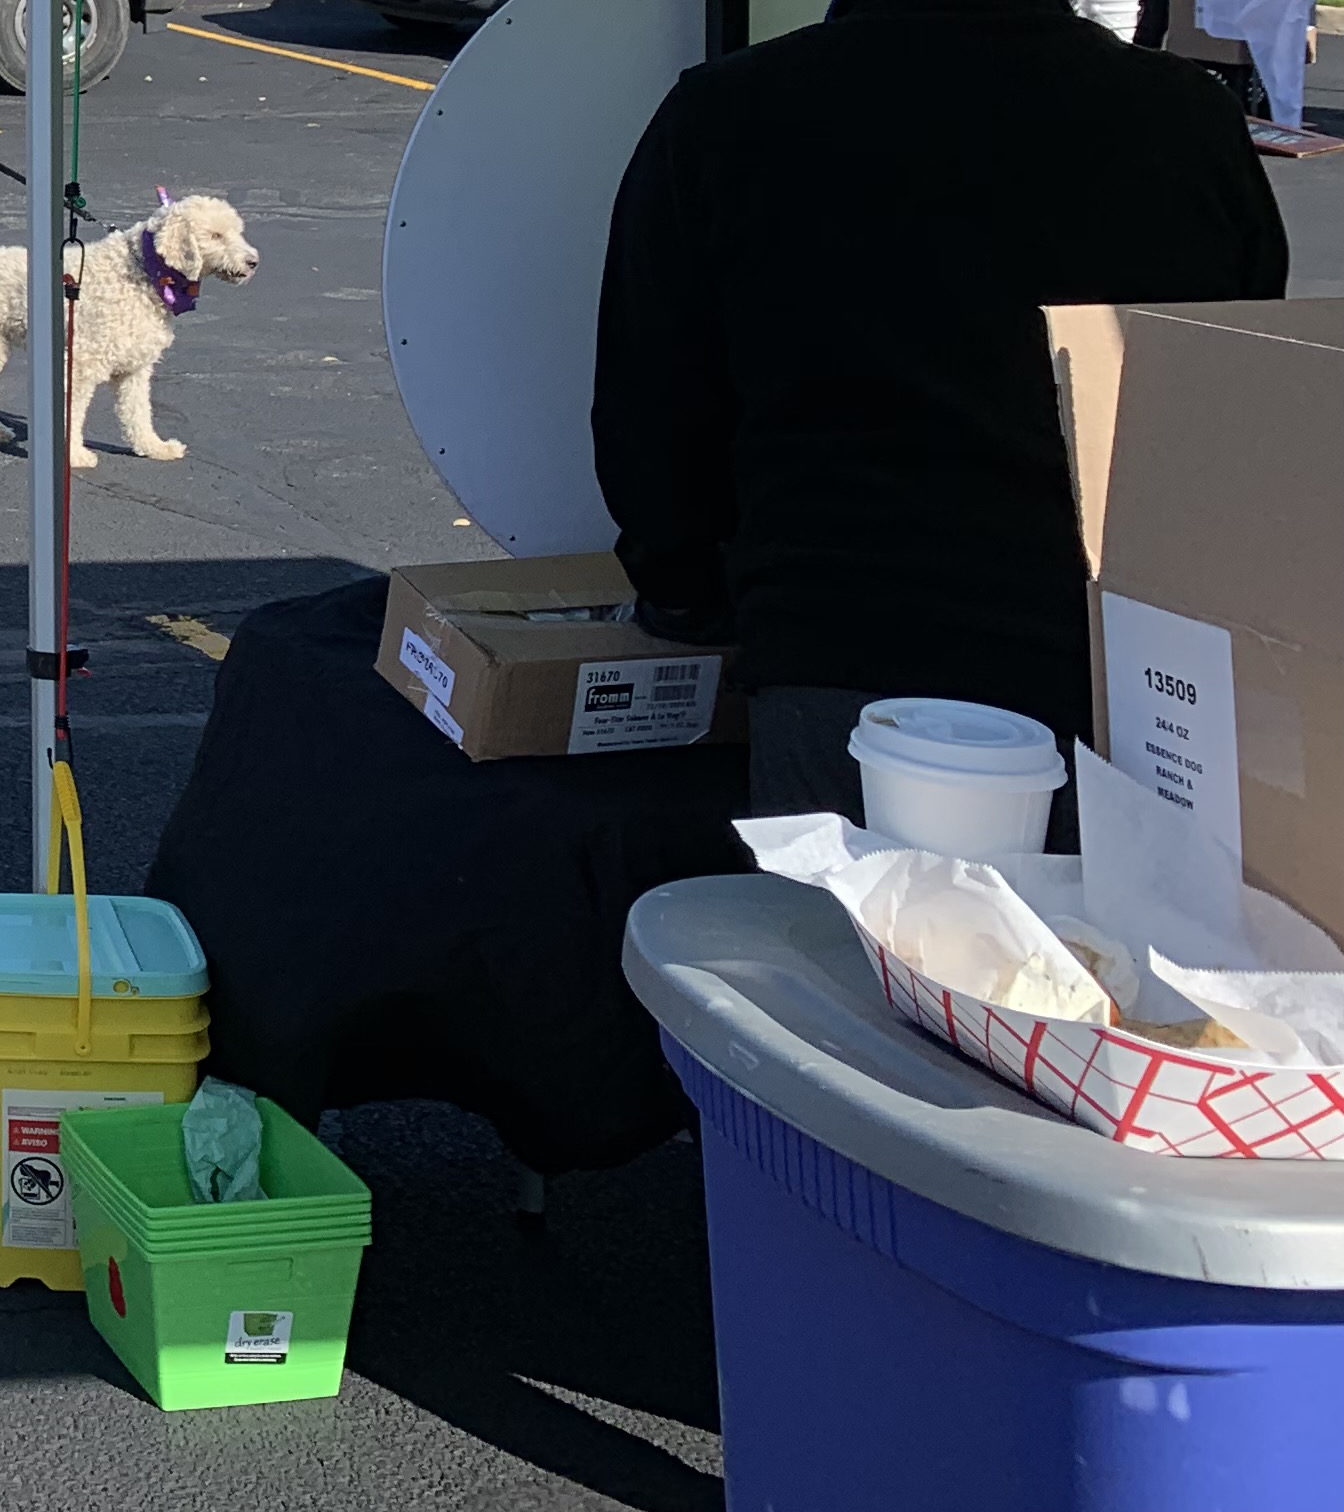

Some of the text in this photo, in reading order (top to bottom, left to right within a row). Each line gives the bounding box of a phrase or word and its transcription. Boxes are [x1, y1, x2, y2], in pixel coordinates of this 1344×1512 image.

[587, 671, 620, 684] 31670
[1145, 668, 1196, 705] 13509
[588, 689, 630, 705] fromm
[1176, 725, 1189, 740] OZ
[1145, 741, 1203, 774] ESSENCE DOG
[1155, 765, 1193, 790] RANCH &
[1157, 786, 1194, 810] MEADOW
[254, 1337, 280, 1347] erase
